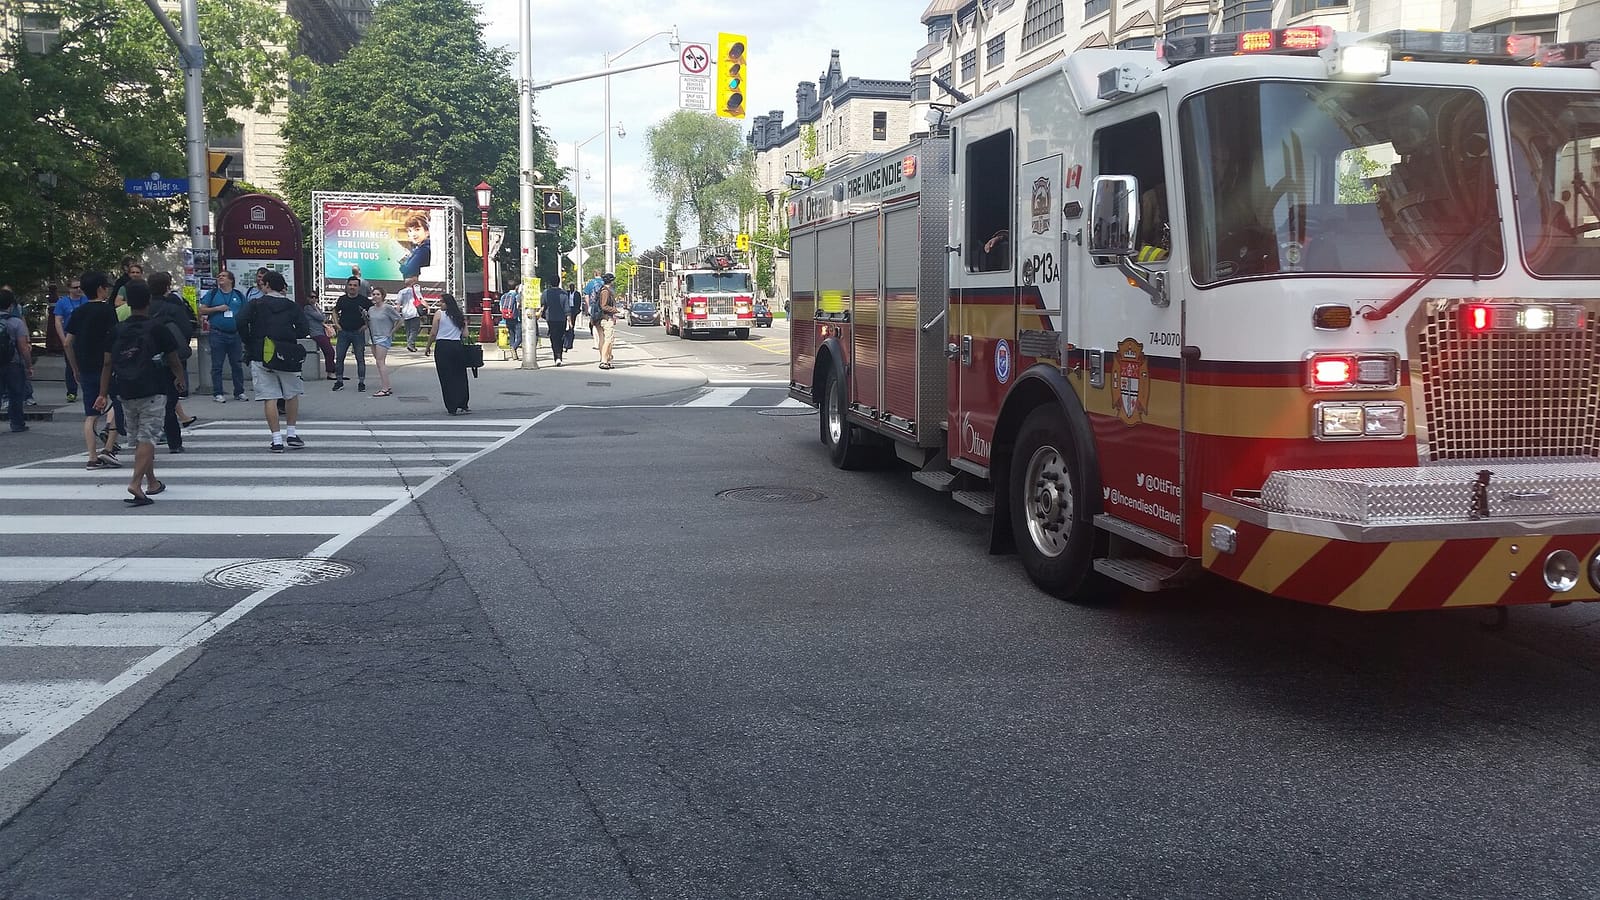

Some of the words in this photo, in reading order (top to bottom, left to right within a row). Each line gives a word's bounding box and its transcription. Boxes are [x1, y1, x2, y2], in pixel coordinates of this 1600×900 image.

[144, 180, 170, 191] Waller
[243, 222, 274, 230] uOttawa
[337, 229, 351, 238] LES
[352, 230, 389, 239] FINANCES
[238, 238, 281, 246] Bienvenue
[337, 240, 380, 250] PUBLIQUES
[241, 246, 278, 254] Welcome
[337, 251, 359, 260] POUR
[360, 252, 379, 261] TOUS
[1149, 332, 1181, 346] 74-D070
[1145, 474, 1182, 498] @OttFire
[1110, 488, 1181, 525] @IncendiesOttawa
